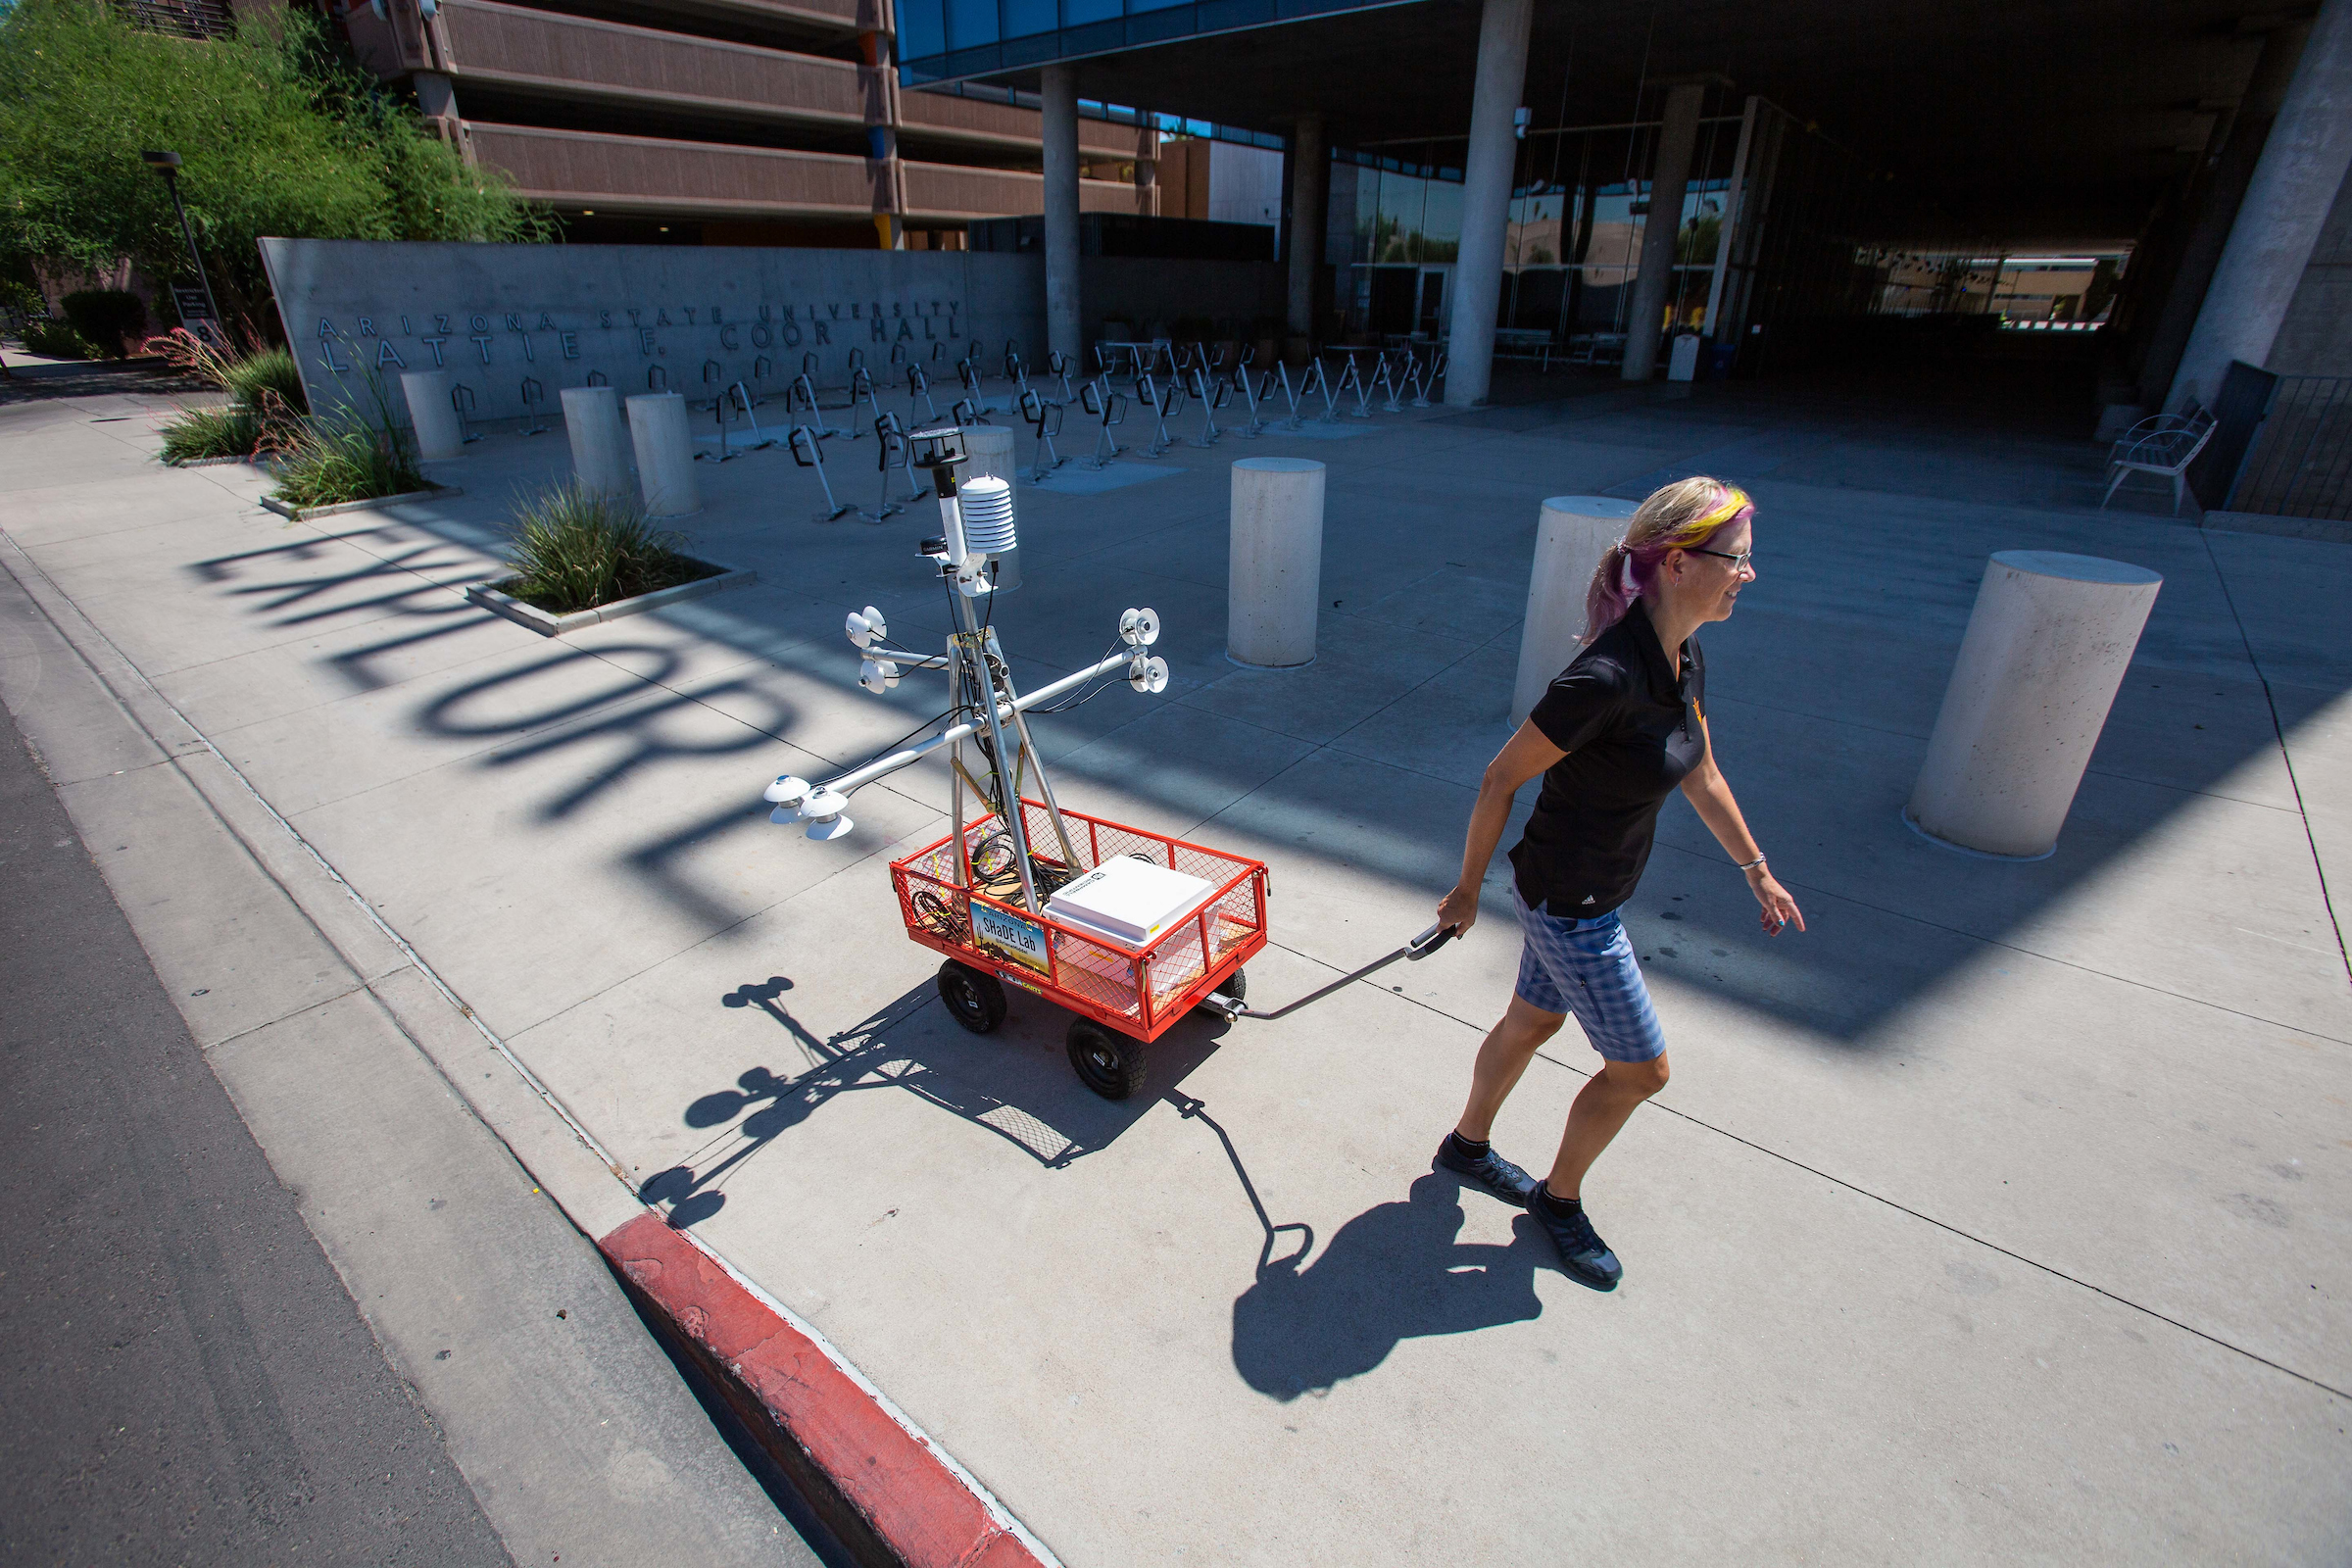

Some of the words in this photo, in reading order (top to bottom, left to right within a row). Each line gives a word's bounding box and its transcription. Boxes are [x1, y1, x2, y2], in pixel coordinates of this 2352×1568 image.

[318, 312, 557, 338] ARIZONA
[599, 306, 723, 328] STATE
[759, 301, 959, 322] UNIVERSITY
[321, 330, 580, 373] LATTIE
[639, 326, 666, 357] F.
[719, 319, 831, 350] COOR
[870, 316, 961, 343] HALL
[983, 916, 1016, 944] SHaDE
[1017, 930, 1037, 953] Lab
[988, 910, 1027, 931] ARIZONA
